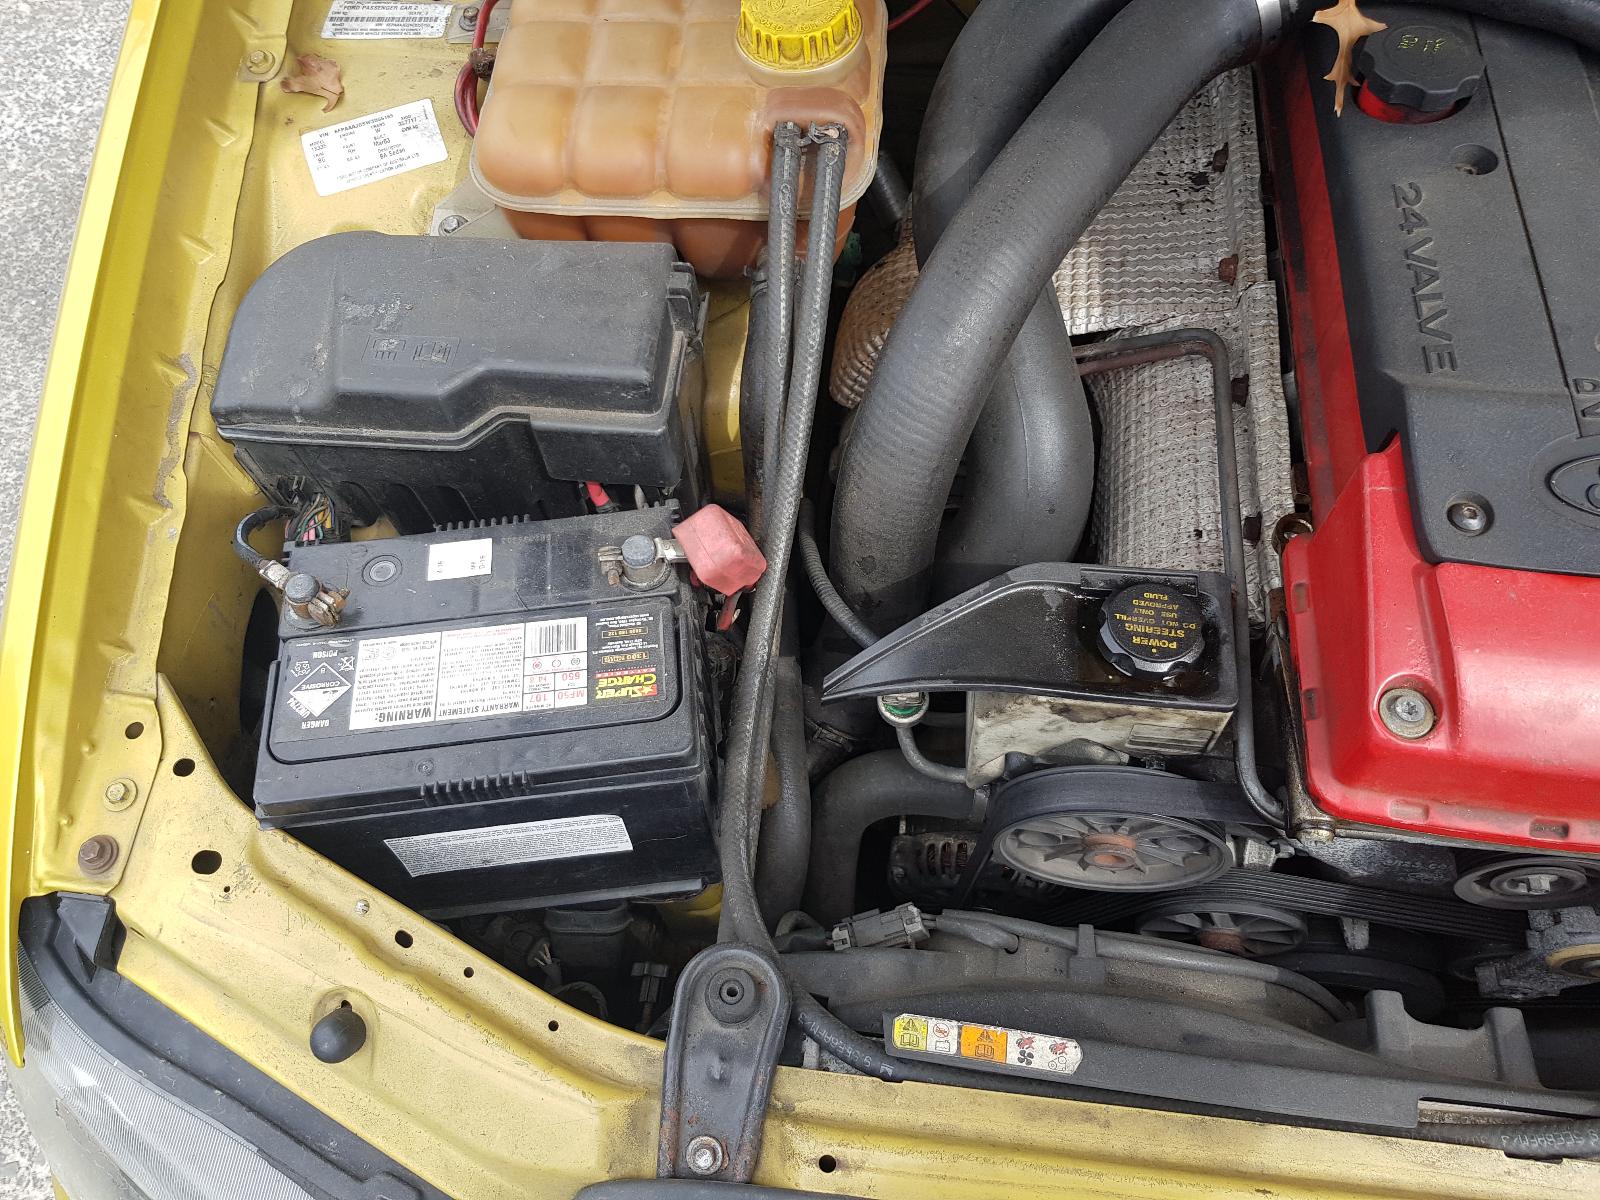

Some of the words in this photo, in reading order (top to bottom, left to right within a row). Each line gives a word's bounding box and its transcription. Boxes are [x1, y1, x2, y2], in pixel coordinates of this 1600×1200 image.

[388, 146, 405, 156] Sedan
[1144, 592, 1168, 601] FLUID
[1132, 599, 1179, 609] APPROVED
[1114, 613, 1155, 624] OVERFILL
[1125, 623, 1185, 638] STEERING
[1132, 636, 1177, 649] POWER
[311, 649, 338, 658] POISON
[300, 680, 340, 690] CORROSIVE
[597, 672, 656, 689] CHARGE
[528, 693, 546, 702] 107
[557, 689, 584, 699] MF50
[594, 685, 644, 701] SUPER
[438, 705, 479, 716] STATEMENT
[481, 701, 519, 711] WARRANTY
[374, 706, 431, 723] WARNING:
[300, 718, 329, 729] DANGER
